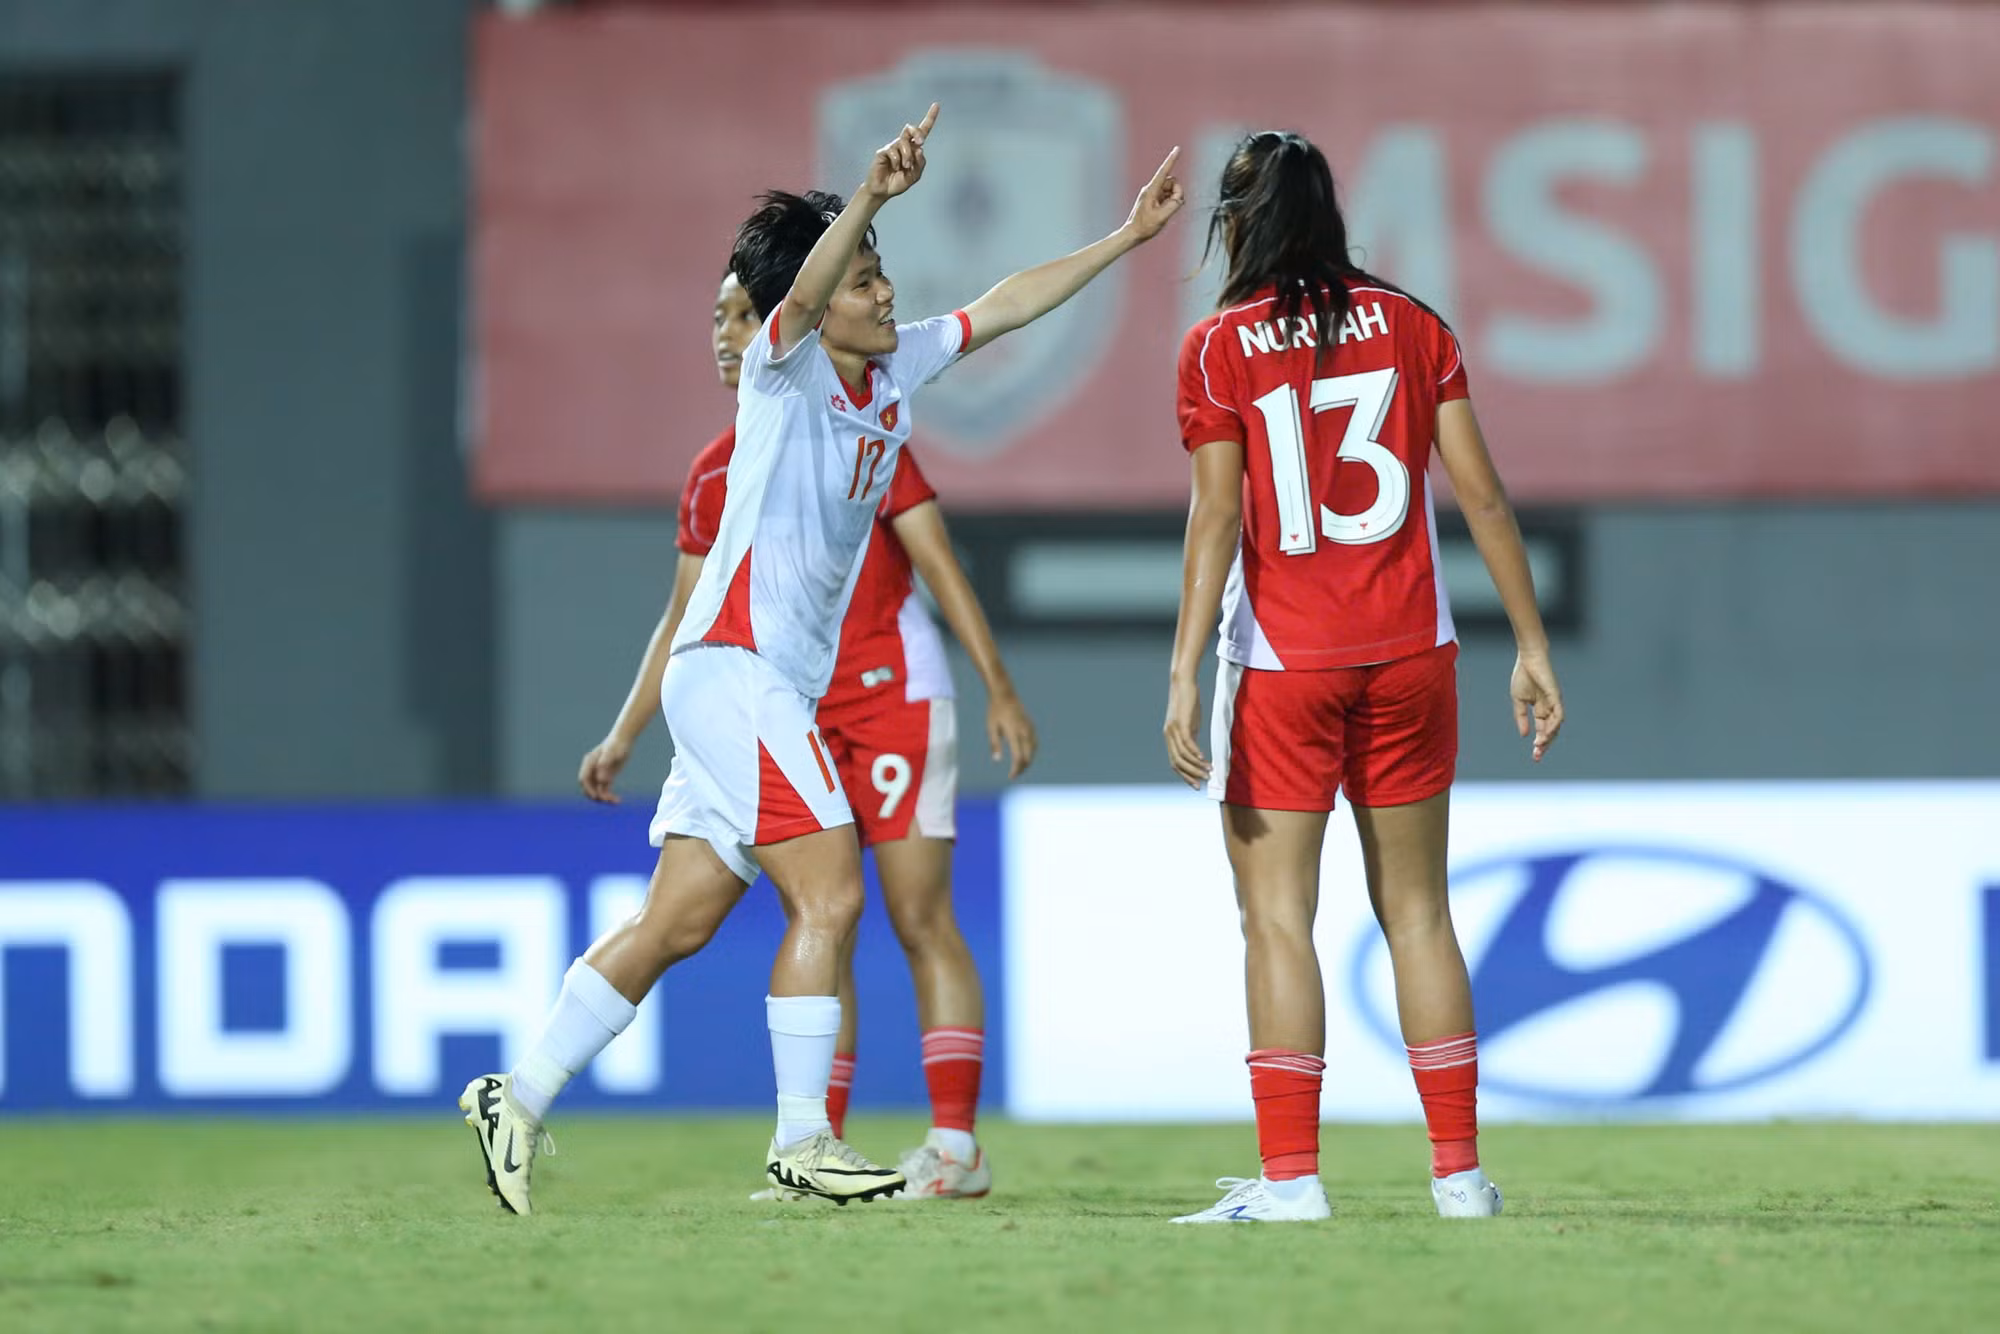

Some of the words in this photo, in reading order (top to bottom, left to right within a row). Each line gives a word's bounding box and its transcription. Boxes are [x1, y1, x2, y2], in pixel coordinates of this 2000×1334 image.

[847, 435, 886, 501] 17
[1252, 367, 1410, 556] 13
[806, 724, 836, 795] 1
[871, 753, 912, 819] 9
